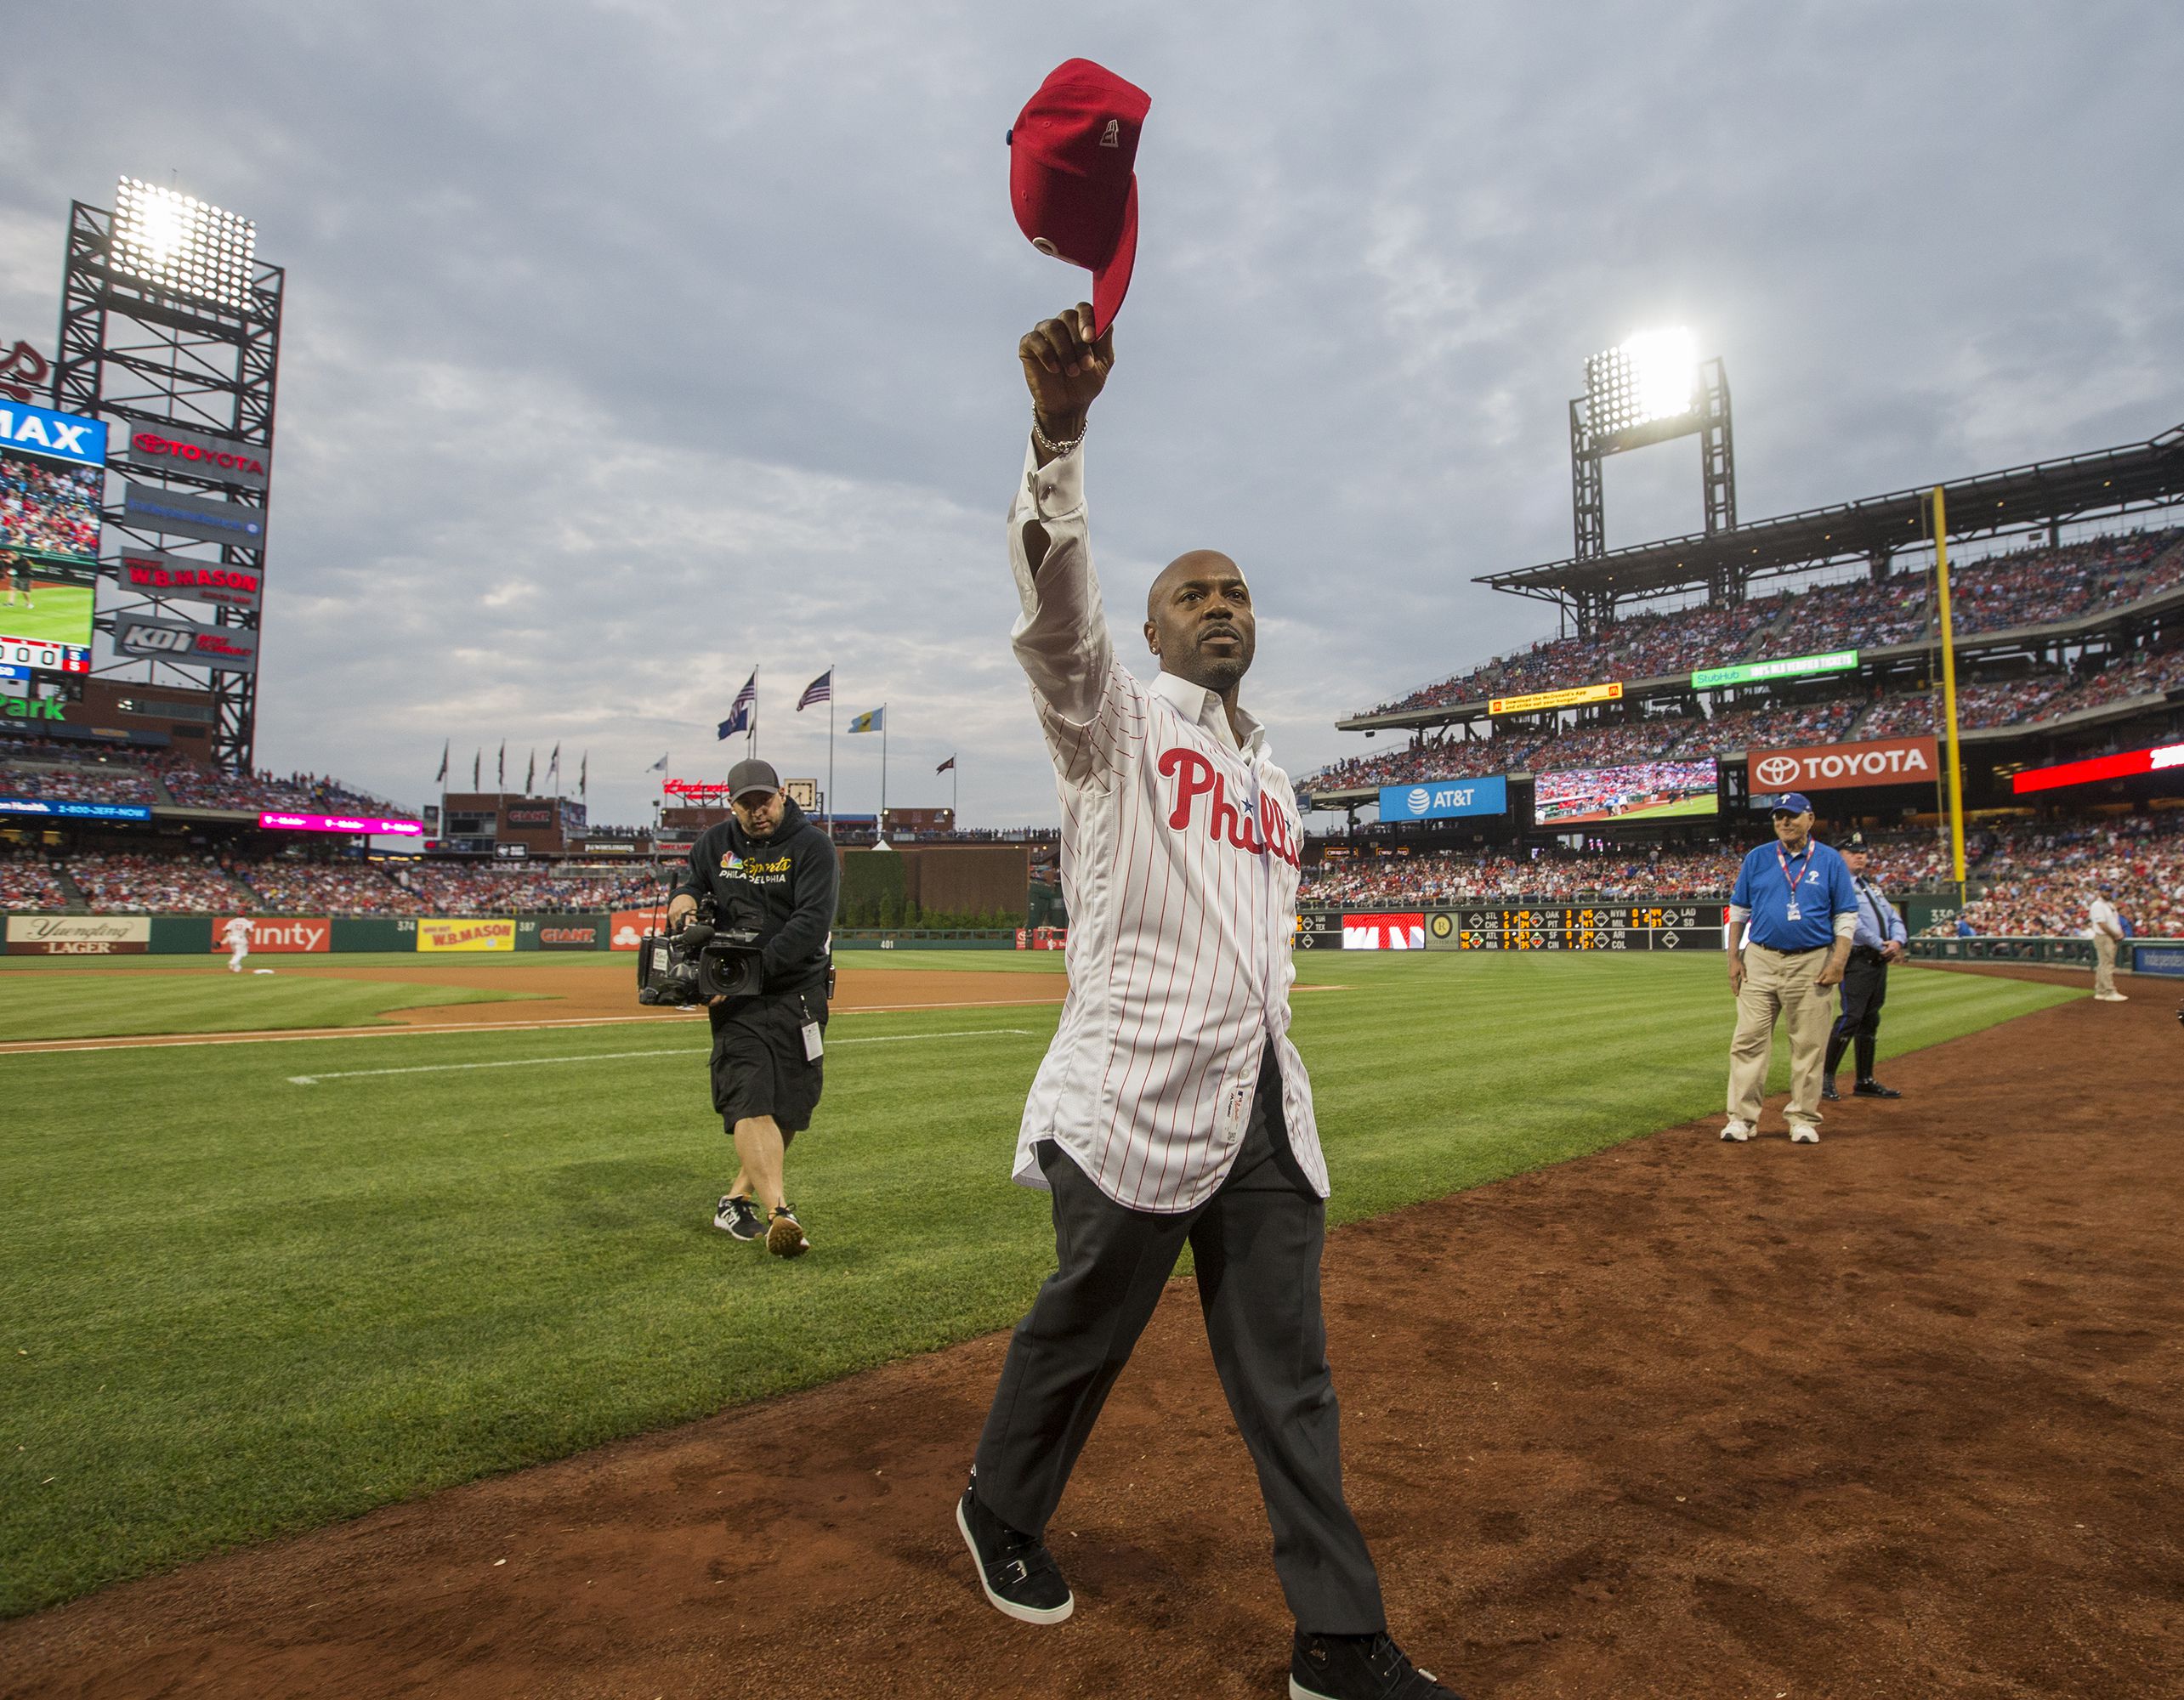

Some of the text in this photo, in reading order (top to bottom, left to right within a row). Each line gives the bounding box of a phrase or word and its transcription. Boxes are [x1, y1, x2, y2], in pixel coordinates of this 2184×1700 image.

[167, 440, 264, 477] TOYOTA
[1697, 672, 1740, 684] StubHub
[1803, 748, 1928, 779] TOYOTA
[1432, 788, 1475, 808] AT&T
[743, 857, 791, 876] Sports
[718, 870, 786, 884] PHILADELPHIA
[1566, 910, 1572, 919] 3
[1610, 910, 1626, 918] NYM
[1681, 908, 1697, 916] LAD
[397, 921, 416, 932] 374
[519, 921, 536, 932] 387
[1484, 921, 1498, 929] CHC
[1612, 919, 1625, 927] MIL
[1683, 918, 1694, 926] SD
[26, 918, 134, 941] Yuengling
[432, 924, 511, 946] W.B.MASON
[1613, 931, 1625, 939] ARI
[254, 922, 325, 951] inity
[540, 928, 596, 944] GIANT
[48, 942, 111, 954] LAGER
[880, 940, 893, 949] 401
[1612, 940, 1626, 949] COL
